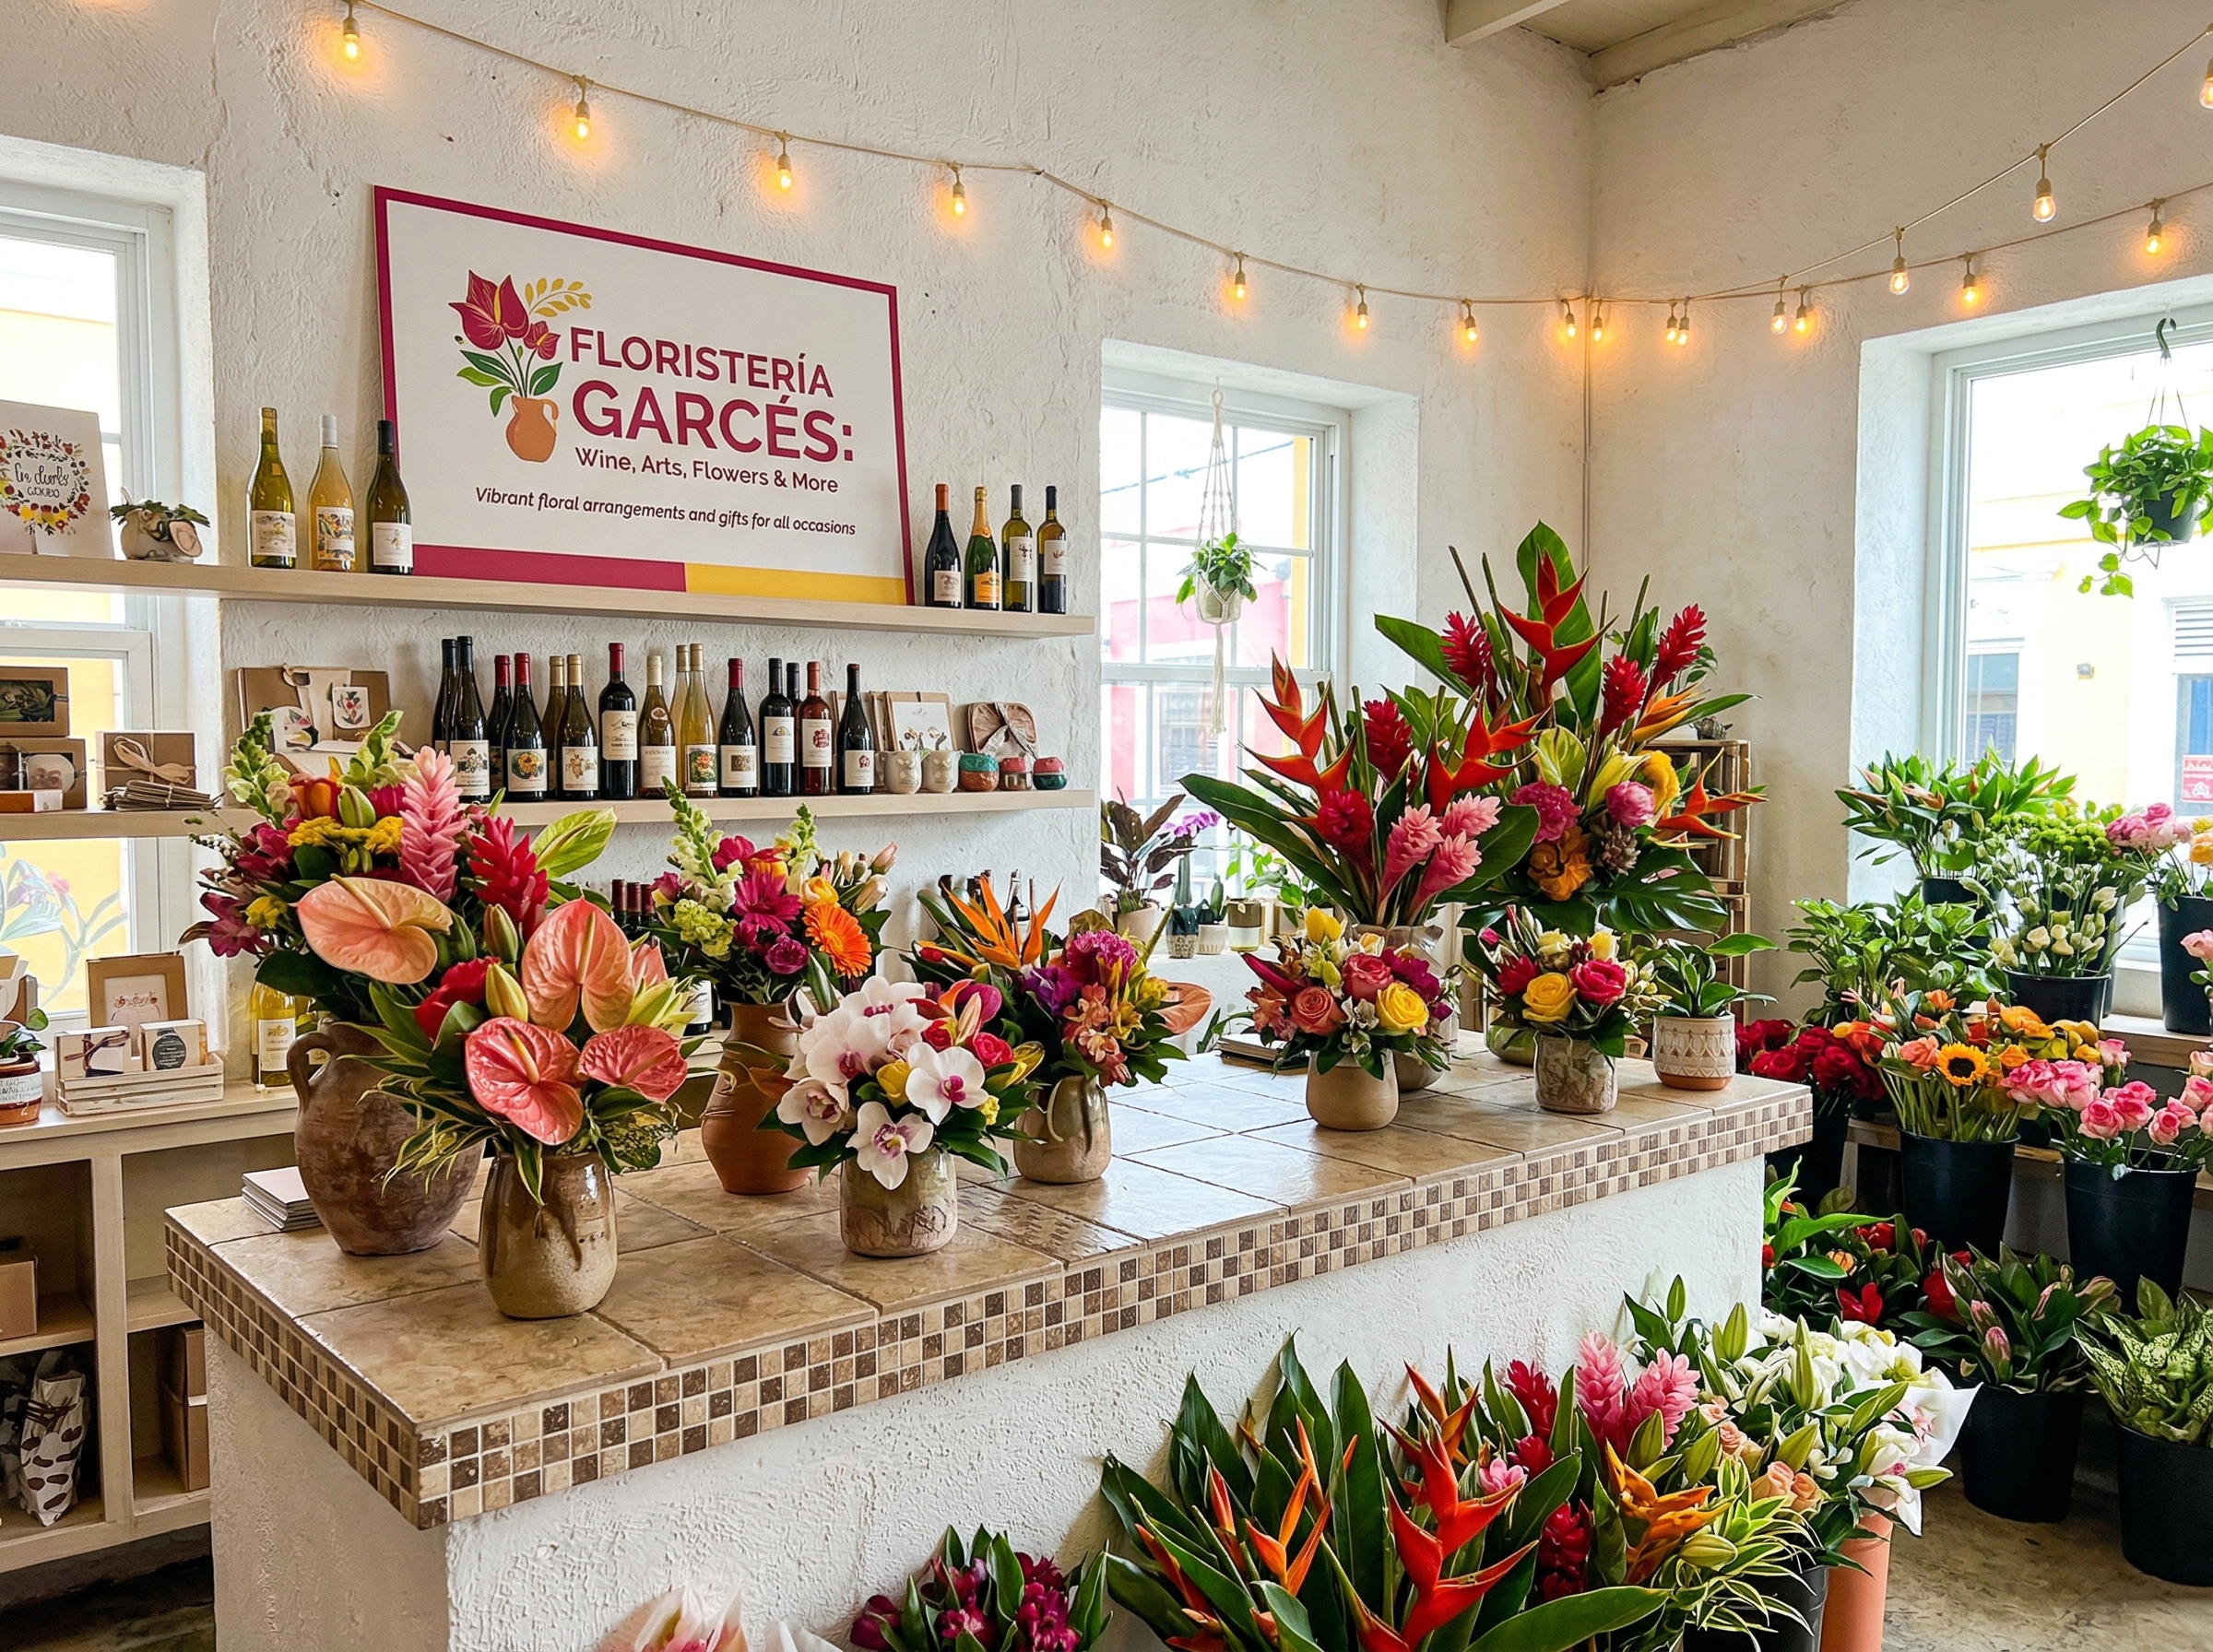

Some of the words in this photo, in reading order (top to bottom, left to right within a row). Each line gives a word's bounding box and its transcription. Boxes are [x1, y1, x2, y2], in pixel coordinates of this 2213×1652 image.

[570, 326, 834, 398] FLORISTERÍA
[572, 379, 854, 463] GARCÉS:
[574, 446, 636, 474] Wine,
[641, 454, 687, 479] Arts,
[692, 460, 769, 486] Flowers
[774, 469, 787, 489] &
[792, 471, 838, 493] More
[476, 487, 535, 507] Vibrant
[538, 491, 579, 512] floral
[583, 500, 685, 520] arrangements
[688, 508, 716, 523] and
[718, 510, 749, 528] gifts
[751, 512, 771, 530] for
[773, 514, 790, 530] all
[792, 519, 856, 536] occasions
